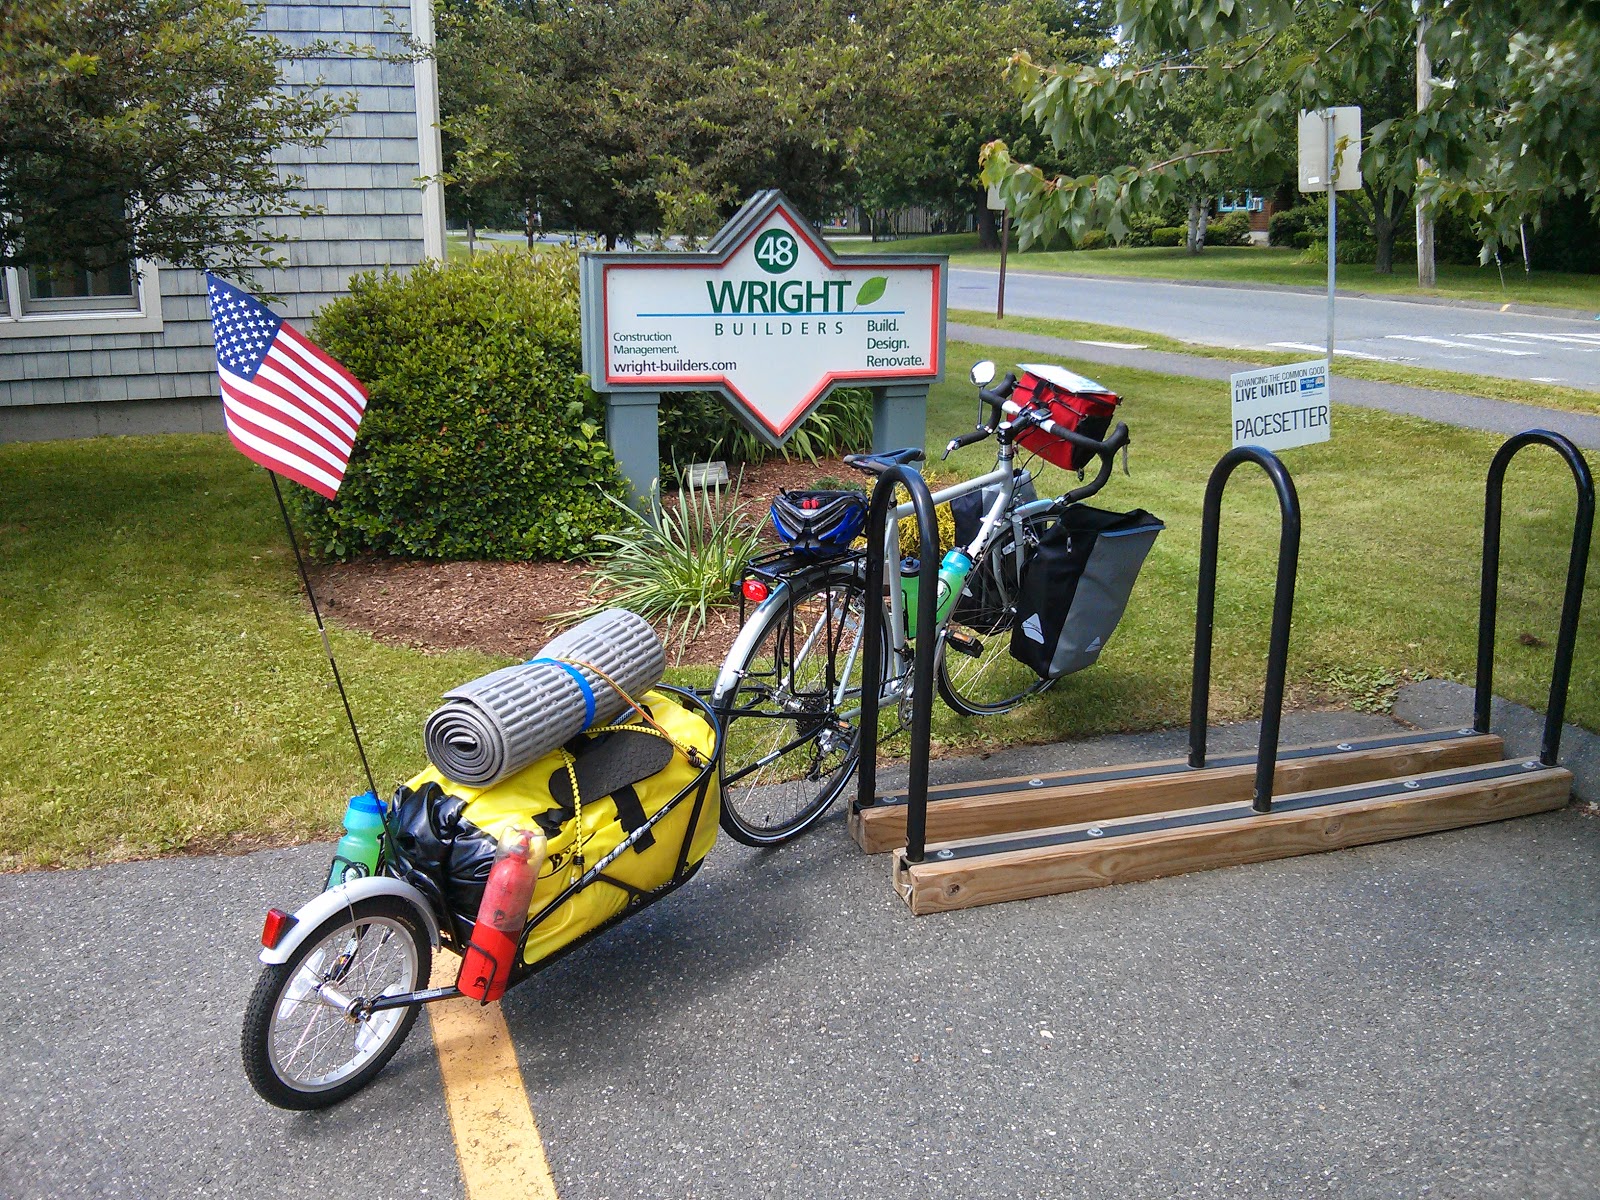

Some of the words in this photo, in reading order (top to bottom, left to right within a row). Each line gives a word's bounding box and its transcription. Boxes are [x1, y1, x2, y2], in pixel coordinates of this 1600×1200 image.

[757, 236, 793, 266] 48
[705, 280, 852, 314] WRIGHT
[714, 321, 844, 336] BUILDERS
[867, 318, 900, 332] Build.
[613, 331, 672, 342] Construction
[866, 336, 910, 352] Design.
[613, 344, 680, 356] Management.
[613, 359, 738, 375] wright-builders.com
[866, 354, 925, 367] Renovate.
[1235, 375, 1268, 389] ADVANCING
[1269, 374, 1280, 383] THE
[1281, 368, 1308, 381] COMMON
[1308, 366, 1325, 376] GOOD
[1235, 386, 1257, 402] LIVE
[1235, 405, 1328, 440] PACESETTER
